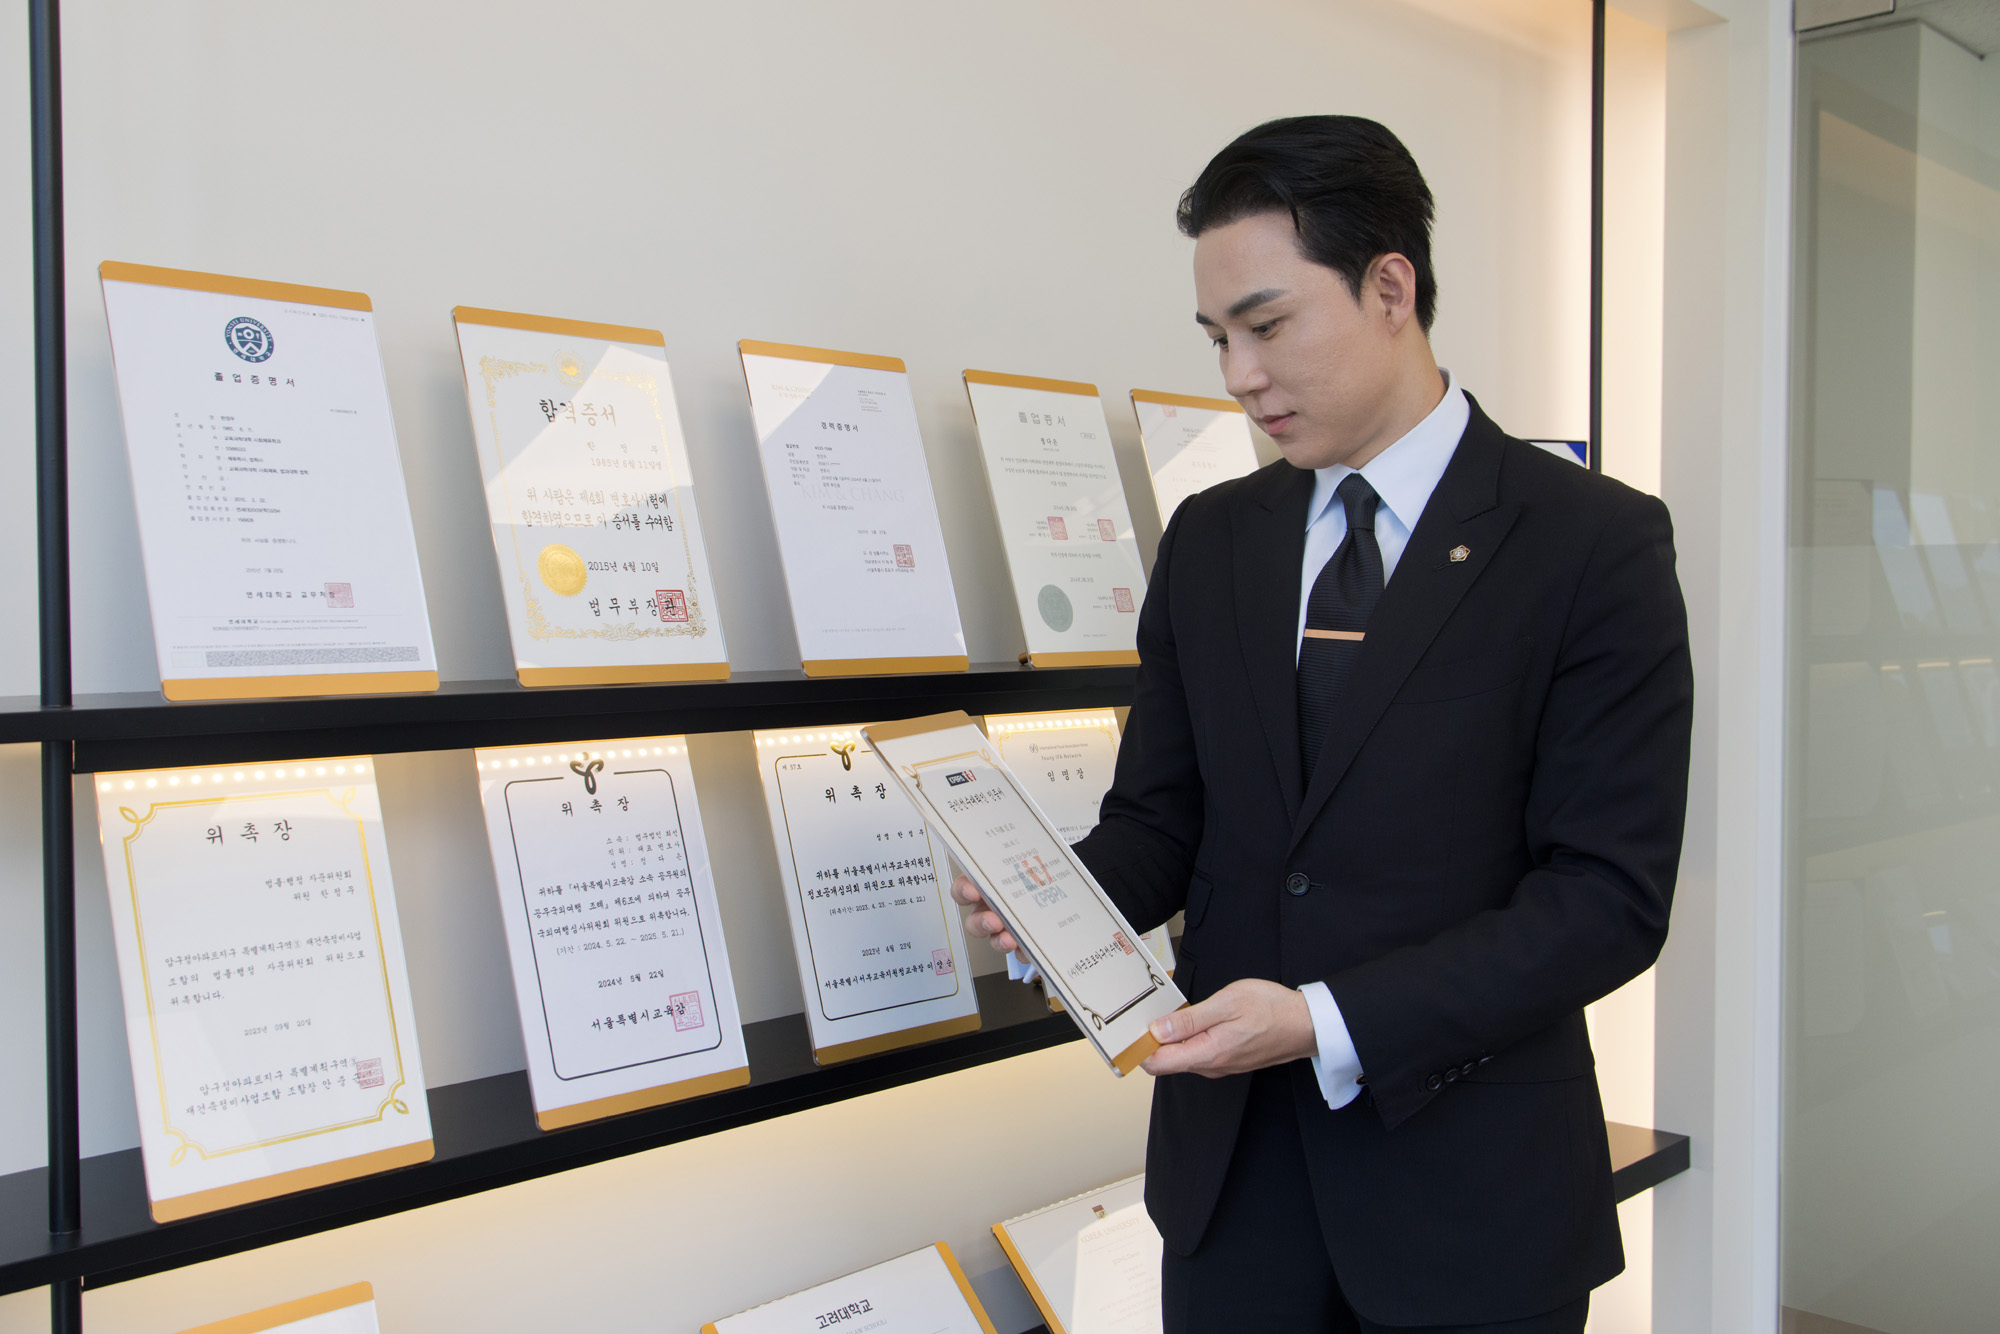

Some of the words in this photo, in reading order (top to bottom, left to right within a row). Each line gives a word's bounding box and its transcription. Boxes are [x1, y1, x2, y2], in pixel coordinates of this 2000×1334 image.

[539, 399, 616, 427] 합격증서
[1018, 411, 1065, 427] 졸업증서
[821, 421, 859, 432] 경력증명서
[527, 487, 537, 503] 위
[543, 488, 574, 506] 사람은
[580, 488, 605, 505] 제4회
[610, 490, 668, 510] 변호사시험에
[801, 485, 831, 499] KIM
[850, 486, 905, 503] CHANG
[521, 509, 594, 528] 합격하였으므로
[597, 512, 607, 529] 이
[612, 512, 641, 531] 증서를
[645, 514, 673, 532] 수여함
[588, 561, 617, 573] 2015년
[622, 561, 636, 573] 4월
[641, 561, 659, 573] 10일
[588, 597, 676, 617] 법무부장관
[1047, 767, 1084, 782] 임명장
[308, 870, 352, 882] 자문위원회
[639, 873, 654, 884] 소속
[657, 868, 687, 882] 공무원의
[843, 856, 931, 877] 서울특별시서부교육지원청
[807, 883, 860, 900] 정보공개심의회
[864, 879, 895, 892] 위원으로
[898, 872, 938, 887] 위촉합니다.
[533, 902, 582, 919] 공무국외여행
[648, 890, 670, 902] 의하여
[676, 887, 691, 899] 공무
[1032, 884, 1068, 909] KPBPA
[537, 919, 610, 939] 국외여행심사위원회
[614, 916, 646, 927] 위원으로
[649, 907, 690, 922] 위촉합니다.
[583, 942, 603, 951] 2024.
[861, 947, 880, 956] 2023년
[885, 944, 895, 953] 4월
[899, 941, 912, 950] 23일
[267, 956, 314, 972] 자문위원회
[598, 976, 623, 988] 2024년
[630, 973, 642, 982] 5월
[648, 969, 665, 979] 22일
[824, 963, 924, 989] 서울특별시서부교육지원청교육장
[591, 1002, 686, 1031] 서울특별시교육감
[200, 1070, 284, 1096] 압구정아파트지구
[815, 1299, 873, 1330] 고려대학교
